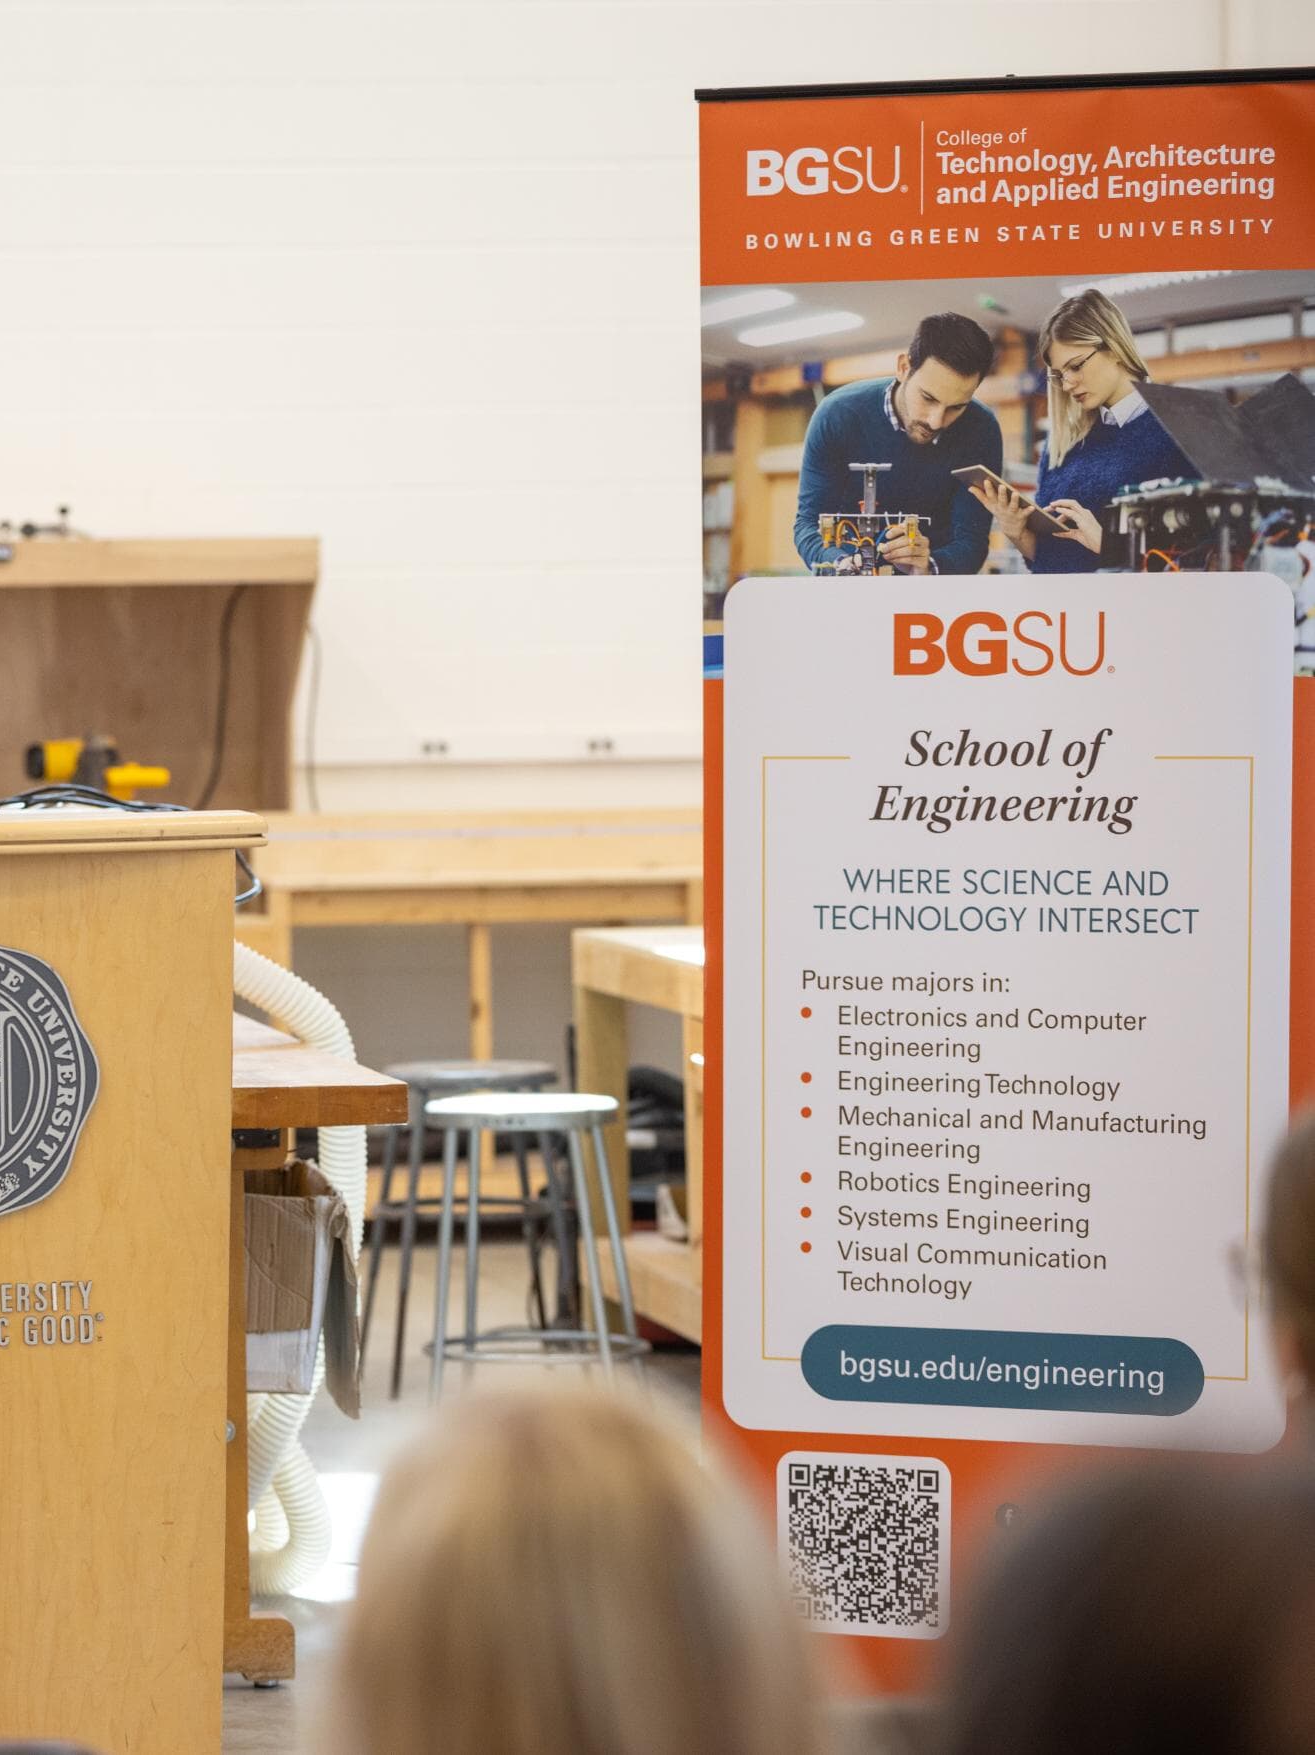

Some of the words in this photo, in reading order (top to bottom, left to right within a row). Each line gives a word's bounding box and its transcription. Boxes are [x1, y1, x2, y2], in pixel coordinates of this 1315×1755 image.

[936, 130, 1004, 148] College
[1009, 128, 1027, 143] of
[936, 149, 1097, 176] Technology,
[1104, 144, 1275, 168] Architecture
[937, 181, 985, 205] and
[992, 177, 1098, 207] Applied
[1108, 173, 1275, 200] Engineering
[746, 231, 871, 249] BOWLING
[890, 228, 978, 245] GREEN
[997, 225, 1079, 242] STATE
[1099, 219, 1272, 238] UNIVERSITY
[905, 729, 1052, 766] School
[1063, 728, 1112, 778] of
[869, 786, 1138, 834] Engineering
[843, 869, 950, 893] WHERE
[963, 870, 1091, 895] SCIENCE
[1103, 871, 1168, 896] AND
[813, 905, 1026, 931] TECHNOLOGY
[1040, 908, 1199, 934] INTERSECT
[803, 970, 883, 990] Pursue
[893, 972, 973, 996] majors
[983, 973, 1009, 992] in:
[839, 1006, 967, 1027] Electronics
[976, 1009, 1018, 1028] and
[1028, 1009, 1146, 1034] Computer
[839, 1036, 980, 1062] Engineering
[22, 989, 77, 1178] UNIVERSITY
[839, 1071, 980, 1098] Engineering
[985, 1074, 1120, 1101] Technology
[839, 1106, 970, 1128] Mechanical
[980, 1110, 1022, 1129] and
[1033, 1110, 1205, 1140] Manufacturing
[839, 1136, 979, 1163] Engineering
[839, 1171, 939, 1193] Robotics
[949, 1174, 1090, 1203] Engineering
[839, 1206, 938, 1230] Systems
[947, 1209, 1088, 1238] Engineering
[838, 1241, 907, 1262] Visual
[918, 1243, 1106, 1269] Communication
[838, 1271, 972, 1300] Technology
[841, 1350, 1163, 1395] bgsu.edu/engineering
